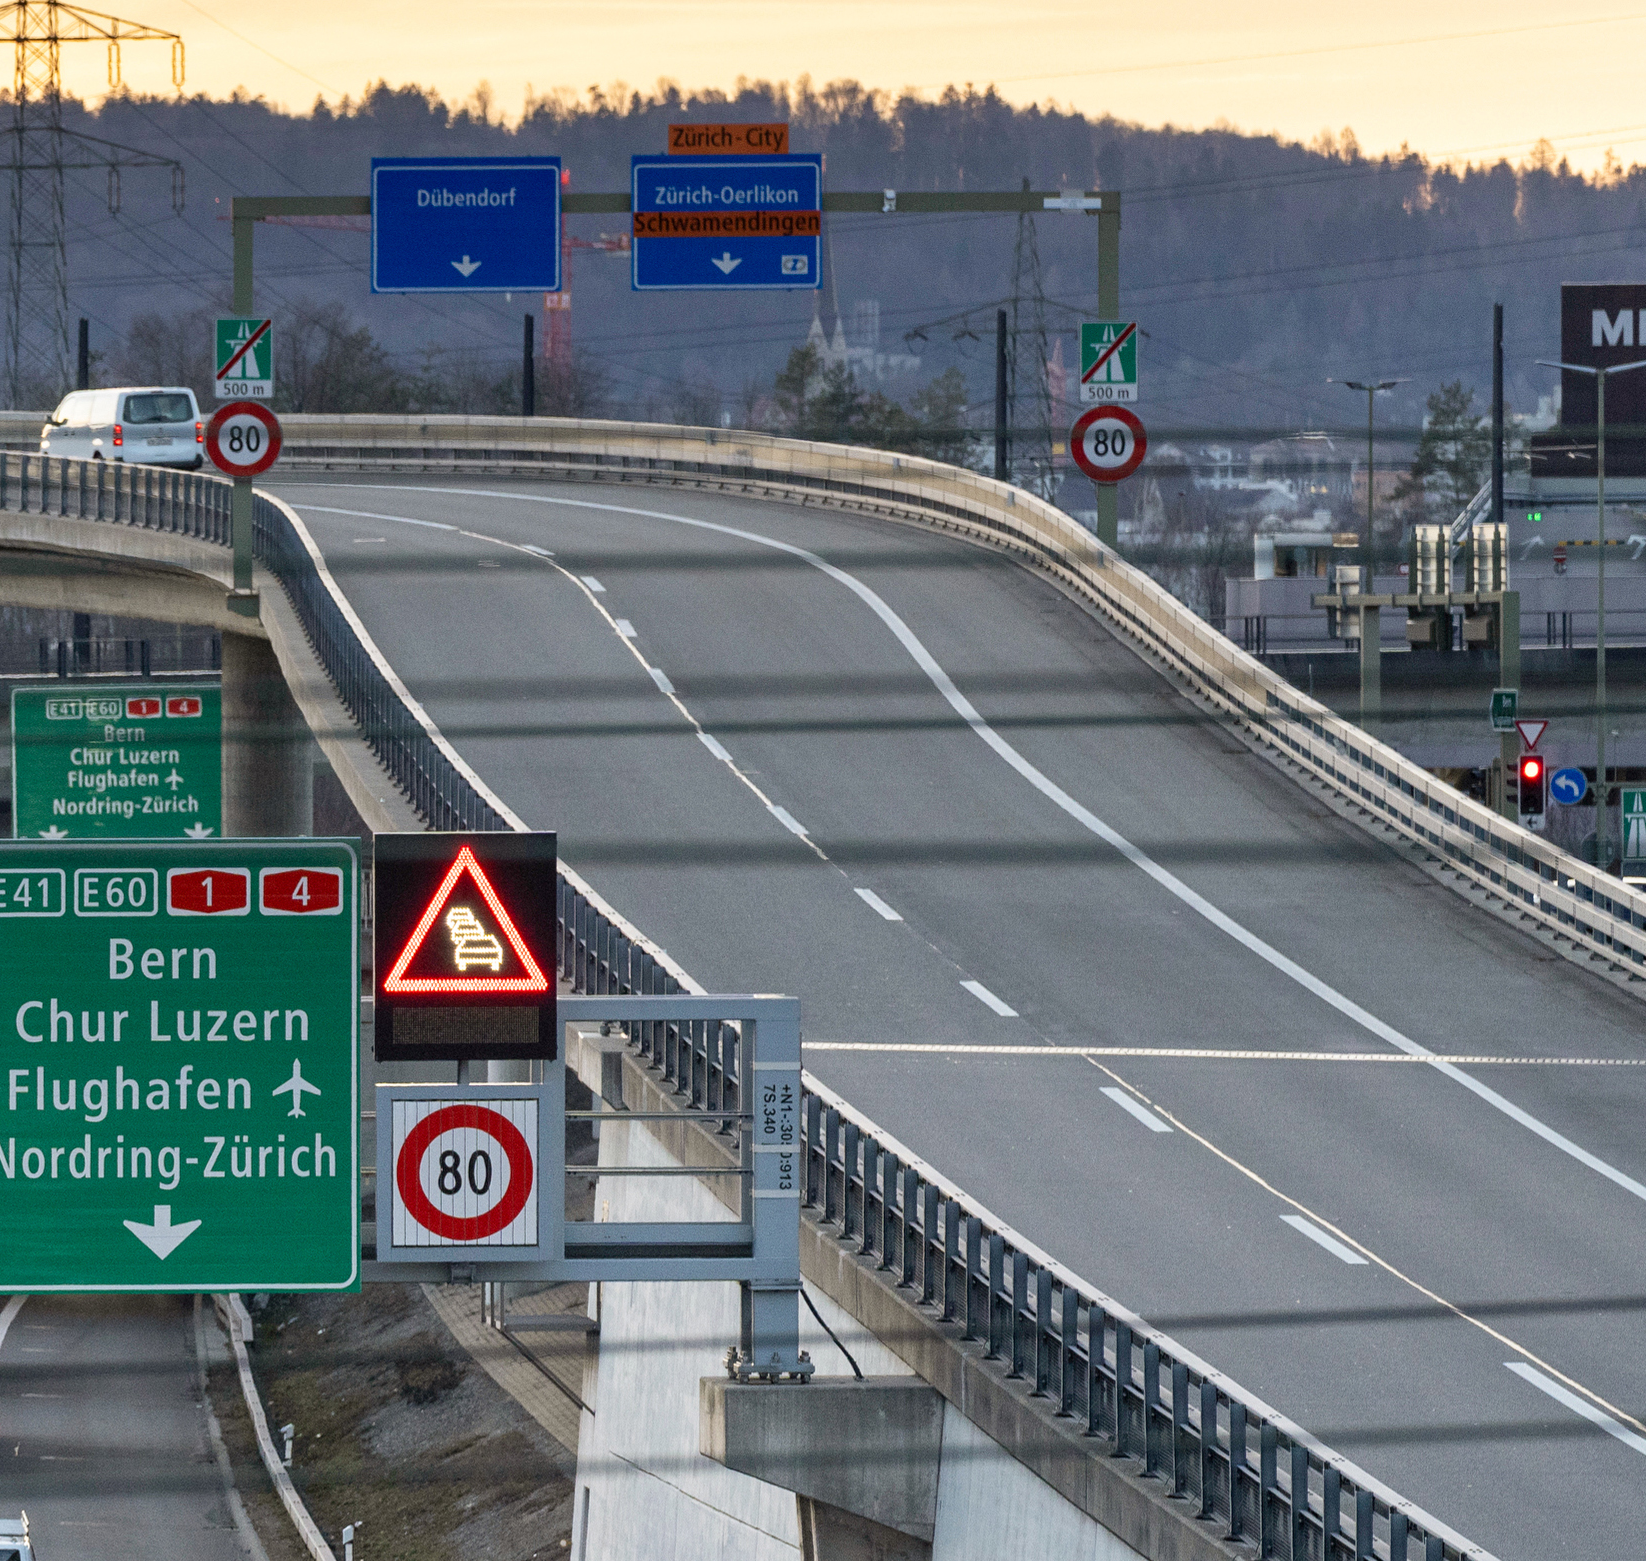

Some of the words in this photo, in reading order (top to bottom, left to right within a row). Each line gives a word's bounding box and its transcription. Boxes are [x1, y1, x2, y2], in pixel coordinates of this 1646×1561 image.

[417, 187, 517, 207] Dübendorf
[655, 185, 799, 205] Zürich-Oerlikon
[634, 211, 820, 236] Schwamendingen
[224, 384, 248, 397] 500
[253, 386, 265, 396] m
[1088, 387, 1113, 400] 500
[1118, 389, 1130, 399] m
[228, 425, 261, 453] 80
[1094, 428, 1126, 456] 80
[140, 701, 148, 714] 1
[179, 701, 188, 714] 4
[104, 724, 146, 742] Bern
[69, 747, 114, 765] Chur
[119, 747, 180, 765] Luzern
[67, 768, 159, 792] Flughafen
[53, 794, 199, 819] Nordring-Zürich
[83, 877, 147, 908] E60
[200, 877, 214, 907] 1
[291, 877, 311, 907] 4
[109, 938, 217, 980] Bern
[15, 998, 129, 1043] Chur
[150, 1000, 309, 1043] Luzern
[8, 1064, 252, 1123] Flughafen
[437, 1149, 493, 1196] 80
